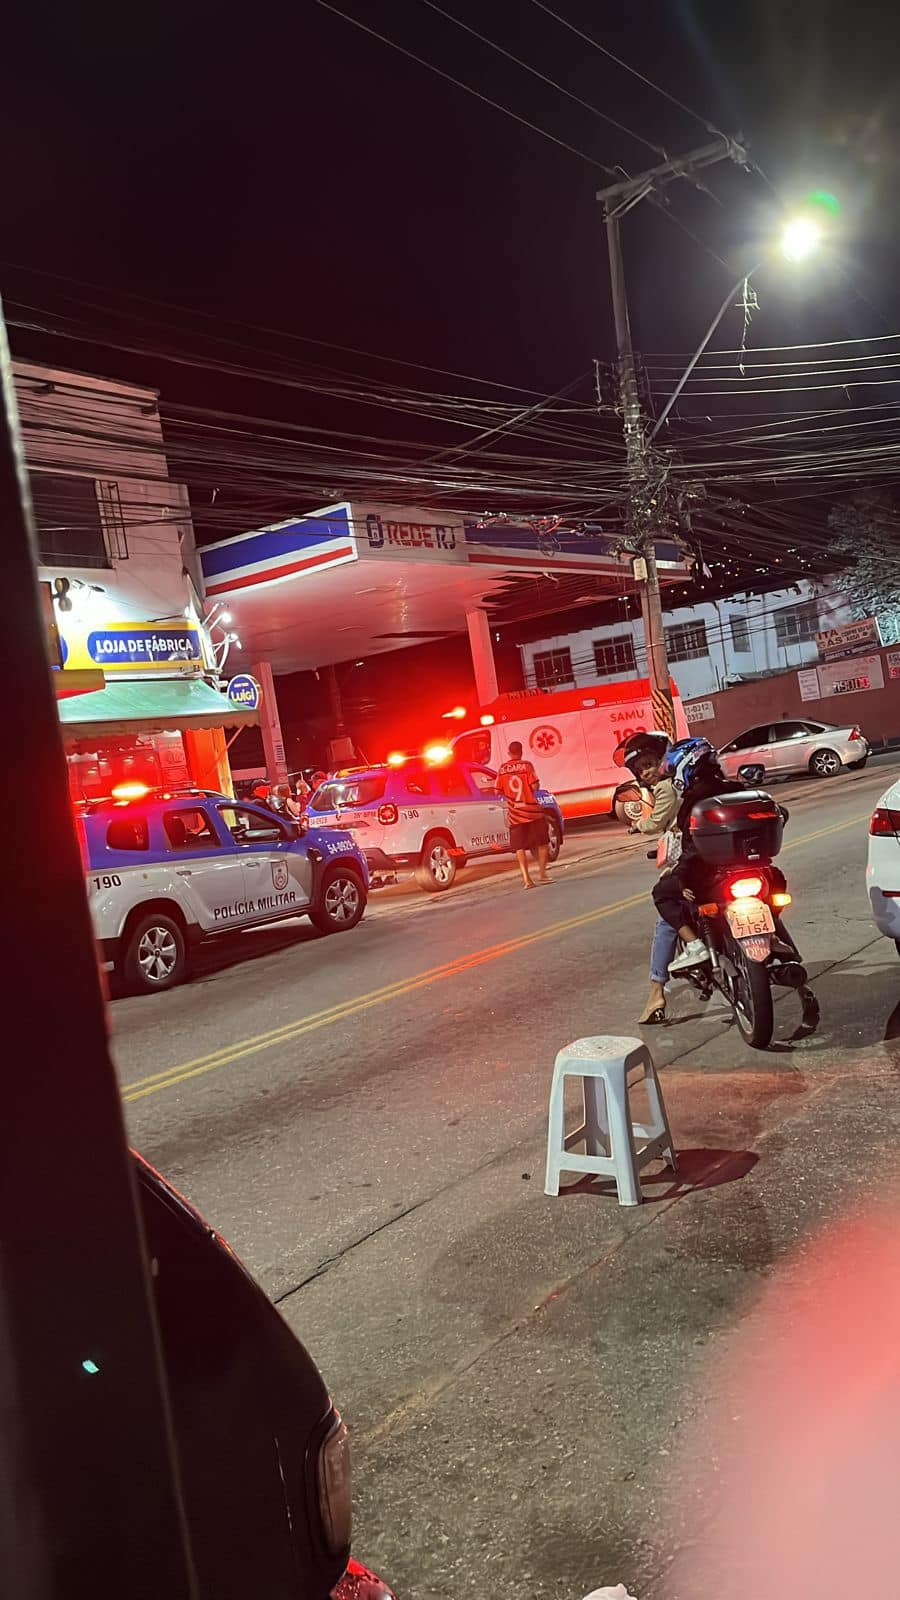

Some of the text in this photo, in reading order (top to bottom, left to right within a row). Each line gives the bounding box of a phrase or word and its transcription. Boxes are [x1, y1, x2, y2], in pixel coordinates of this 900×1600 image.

[387, 523, 456, 549] REDE RJ
[818, 629, 838, 640] ITA
[95, 635, 193, 653] LOJA DE FÁBRICA
[610, 709, 644, 722] SAMU
[509, 775, 523, 802] 9
[93, 874, 121, 890] 190
[213, 891, 296, 920] POLÍCIA MILITAR
